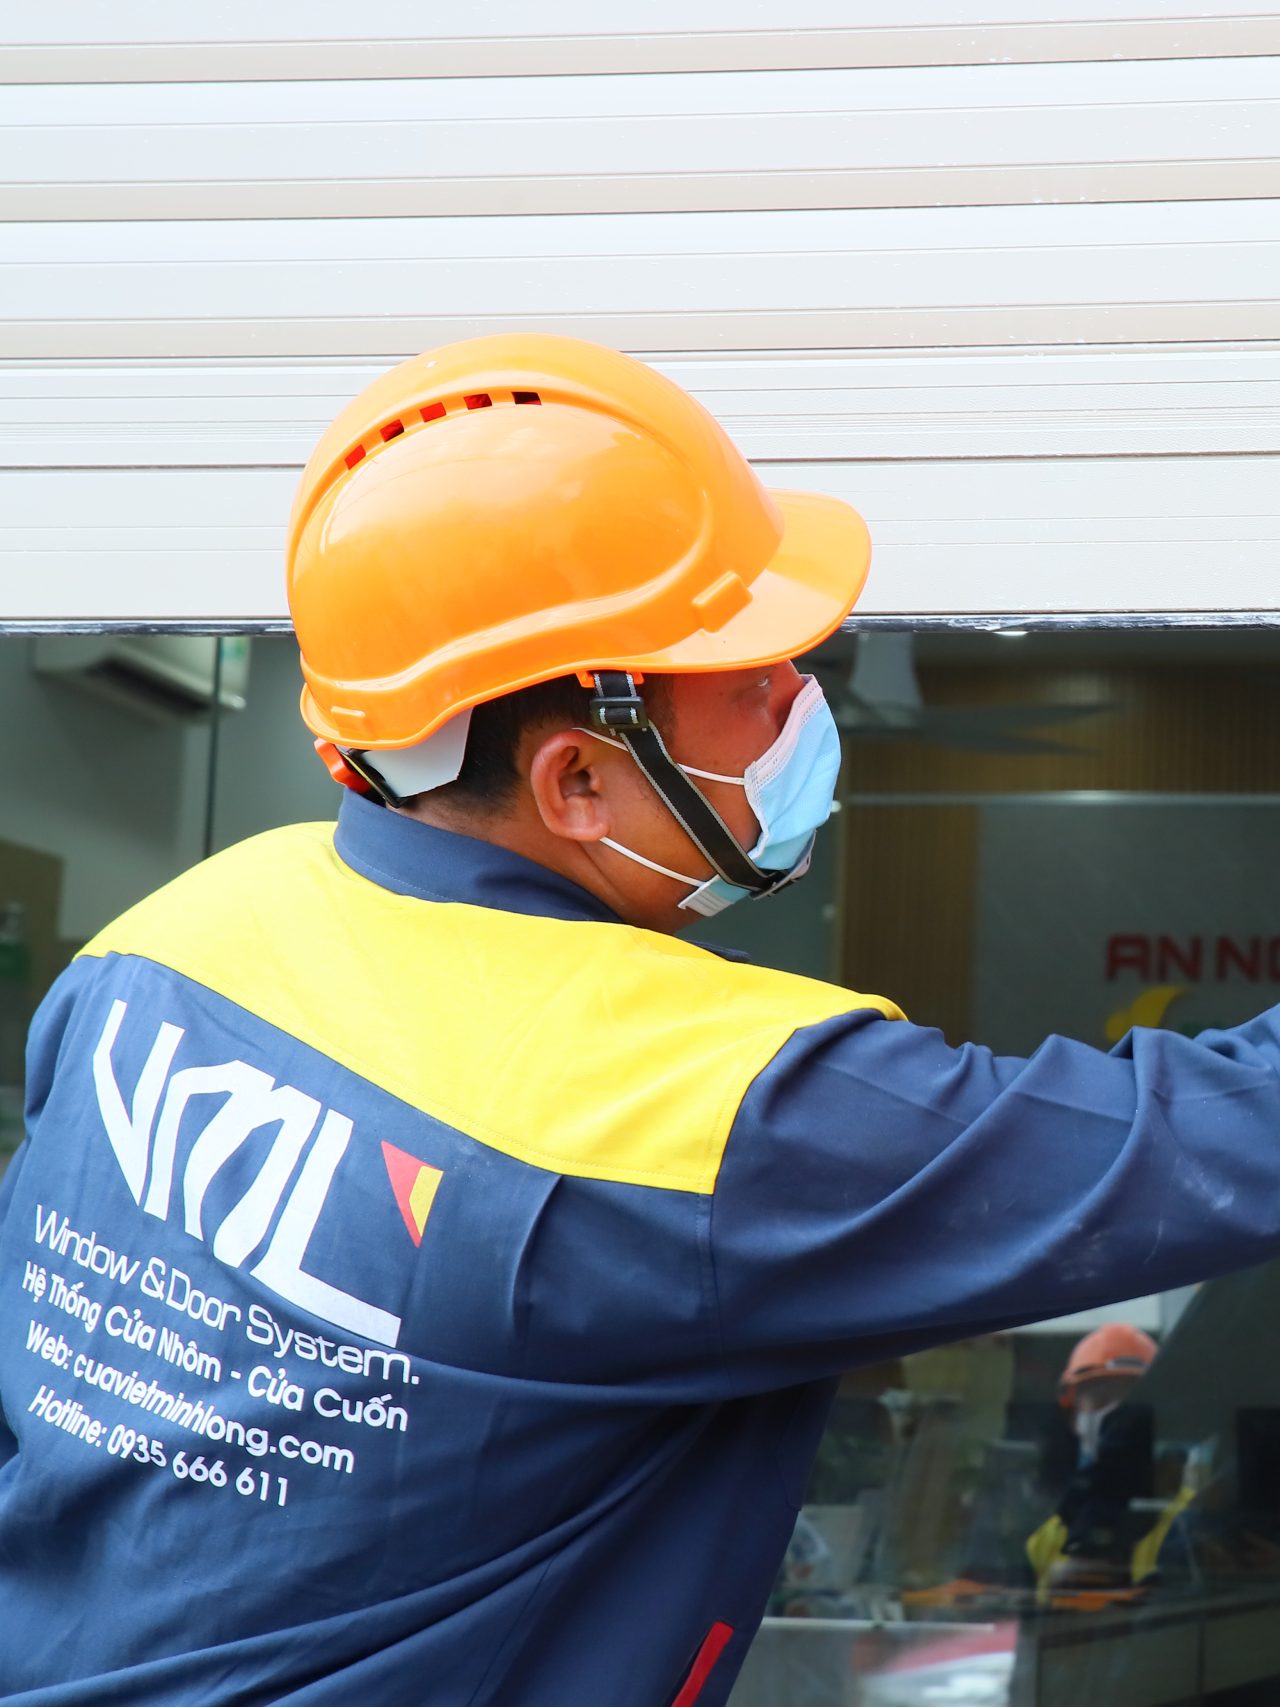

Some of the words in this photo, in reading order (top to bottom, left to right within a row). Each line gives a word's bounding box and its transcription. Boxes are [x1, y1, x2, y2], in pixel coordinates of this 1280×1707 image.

[22, 1260, 47, 1303] Hệ
[48, 1274, 102, 1333] Thống
[104, 1305, 156, 1351] Cửa
[157, 1327, 221, 1382] Nhôm
[247, 1366, 304, 1411] Cửa
[313, 1389, 408, 1432] Cuốn
[35, 1204, 140, 1285] Window
[246, 1304, 421, 1385] System.
[26, 1320, 73, 1370] Web:
[73, 1353, 355, 1474] cuavietminhlong.com
[28, 1385, 108, 1447] Hotline:
[107, 1424, 168, 1468] 0935
[172, 1451, 228, 1488] 666
[235, 1467, 289, 1508] 611
